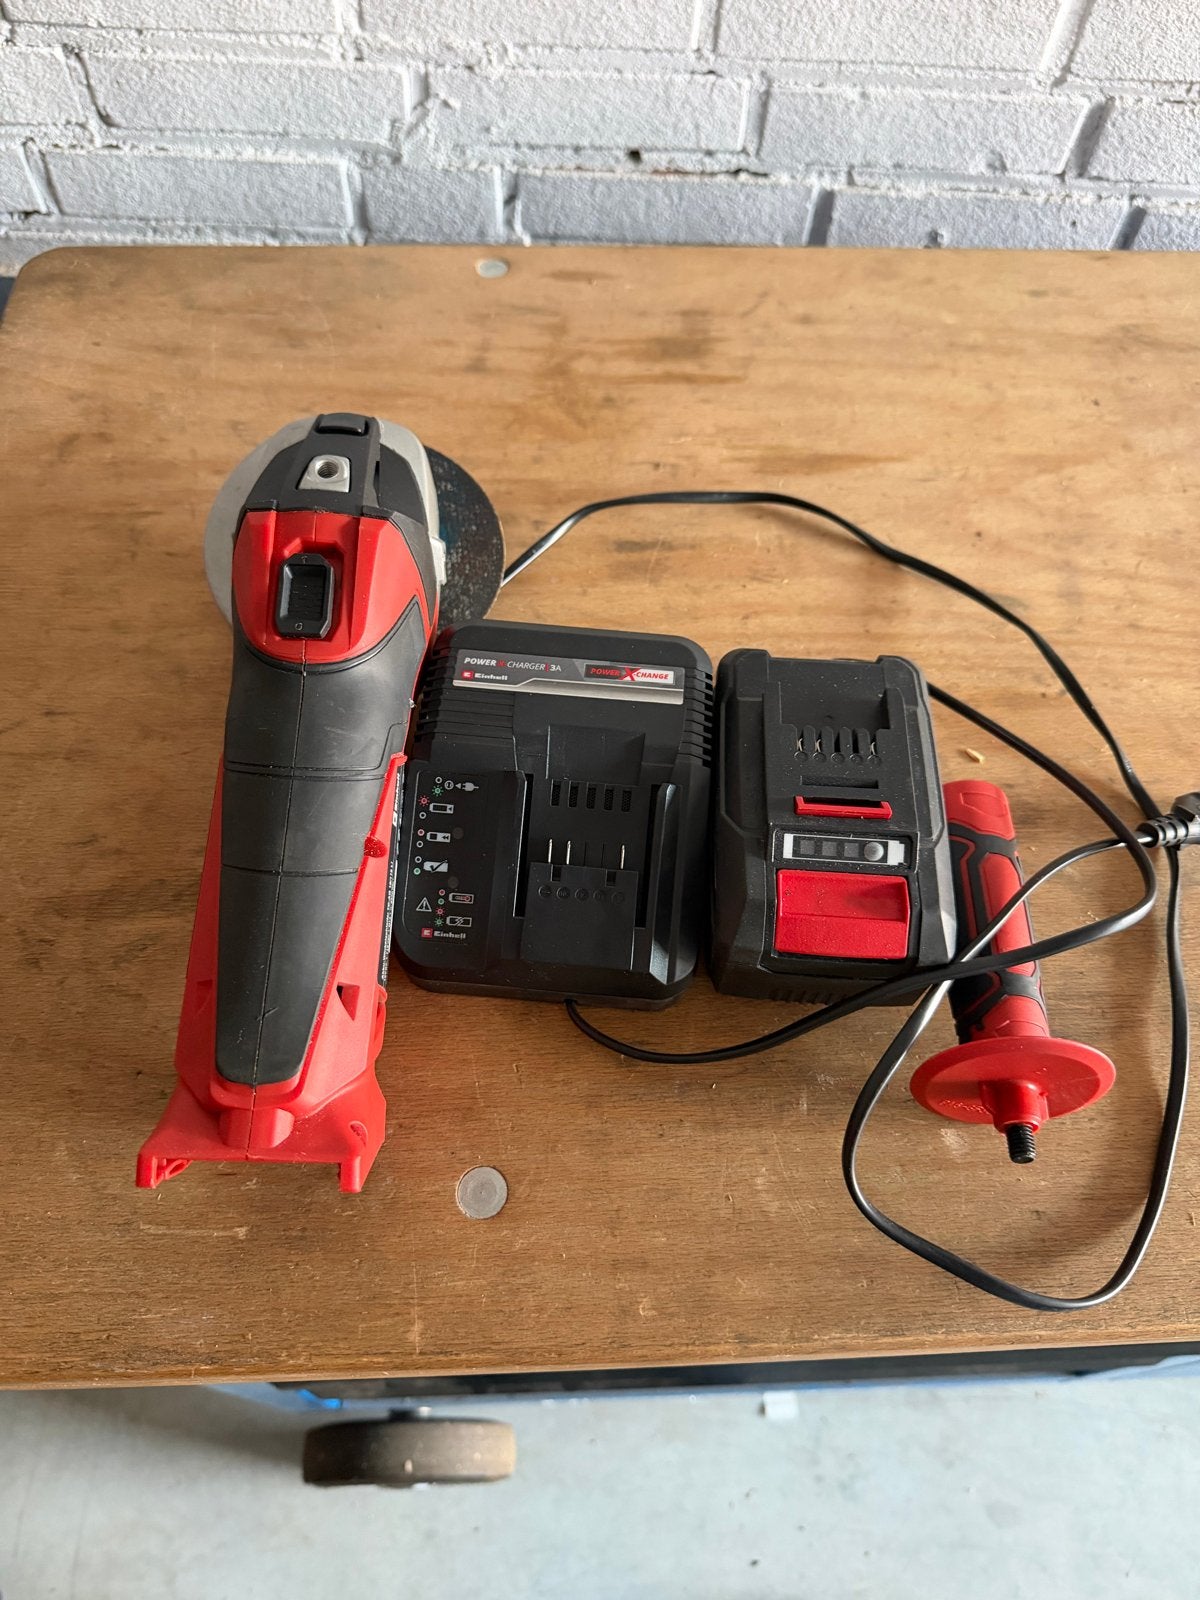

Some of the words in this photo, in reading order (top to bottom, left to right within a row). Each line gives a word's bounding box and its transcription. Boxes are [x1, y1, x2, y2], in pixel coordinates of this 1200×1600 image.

[464, 657, 497, 666] POWER
[474, 672, 508, 681] Einhell
[591, 668, 620, 676] POWER
[433, 930, 466, 940] Einhell
